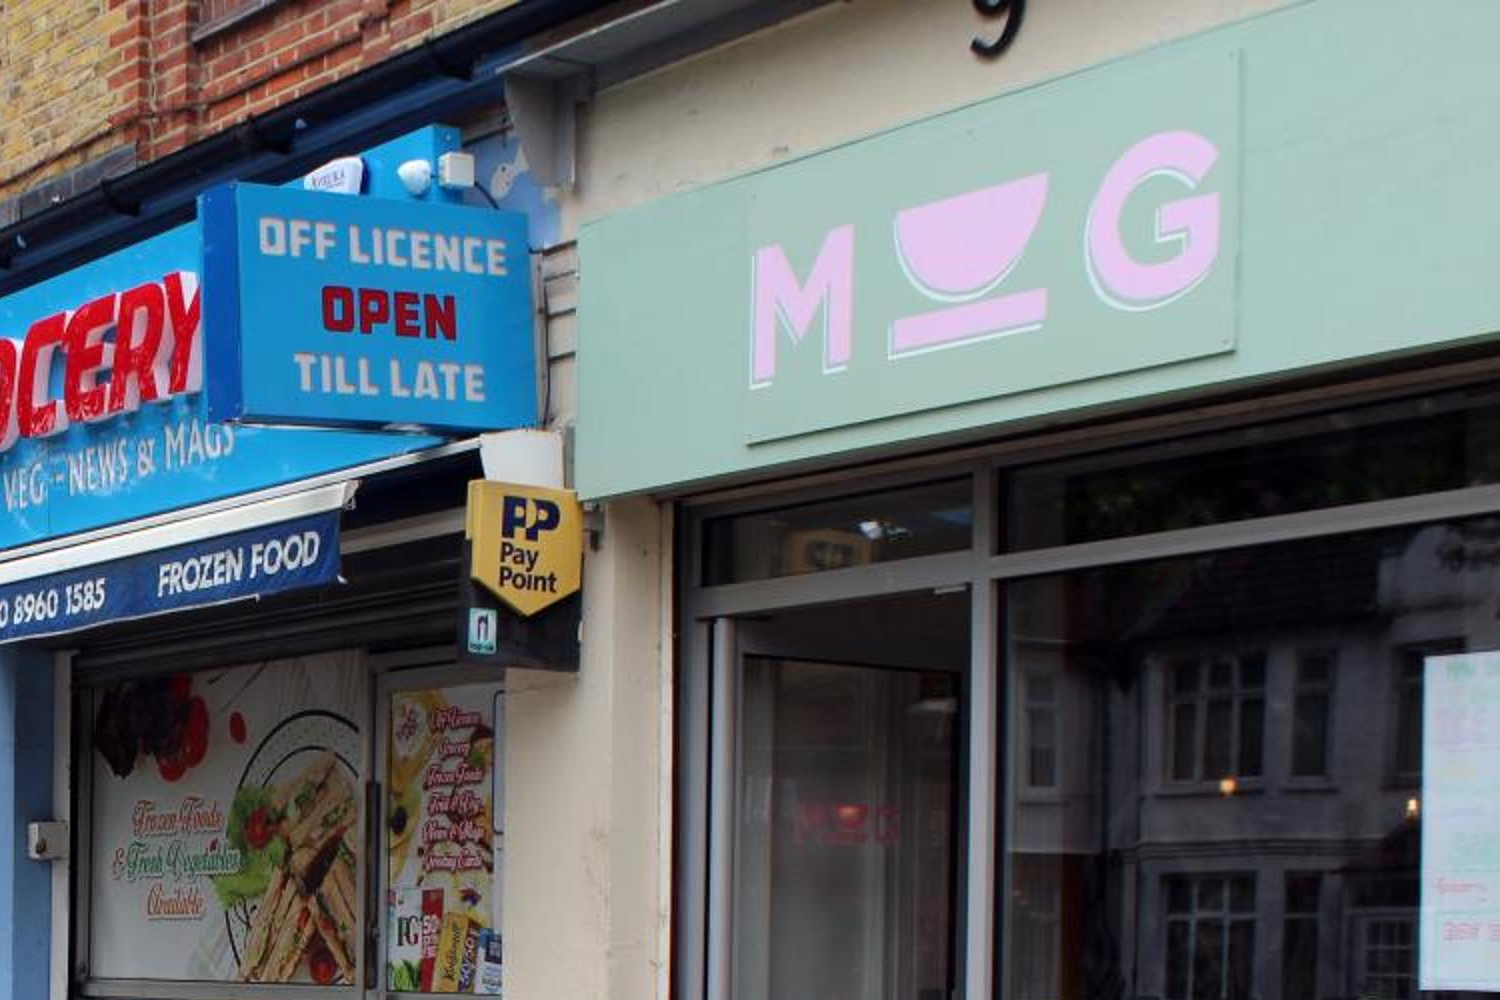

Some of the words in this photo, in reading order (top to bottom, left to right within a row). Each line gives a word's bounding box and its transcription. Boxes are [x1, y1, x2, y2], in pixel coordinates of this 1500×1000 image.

[259, 216, 337, 260] OFF
[350, 224, 509, 277] LICENCE
[321, 284, 458, 342] OPEN
[293, 352, 380, 396] TILL
[390, 358, 486, 402] LATE
[3, 464, 45, 512] VEG
[67, 439, 130, 497] NEWS
[137, 441, 156, 474] &
[157, 552, 244, 599] FROZEN
[250, 531, 320, 580] FOOD
[499, 565, 558, 593] Point
[500, 541, 539, 573] Pay
[13, 588, 59, 627] 8960
[64, 577, 106, 617] 1585
